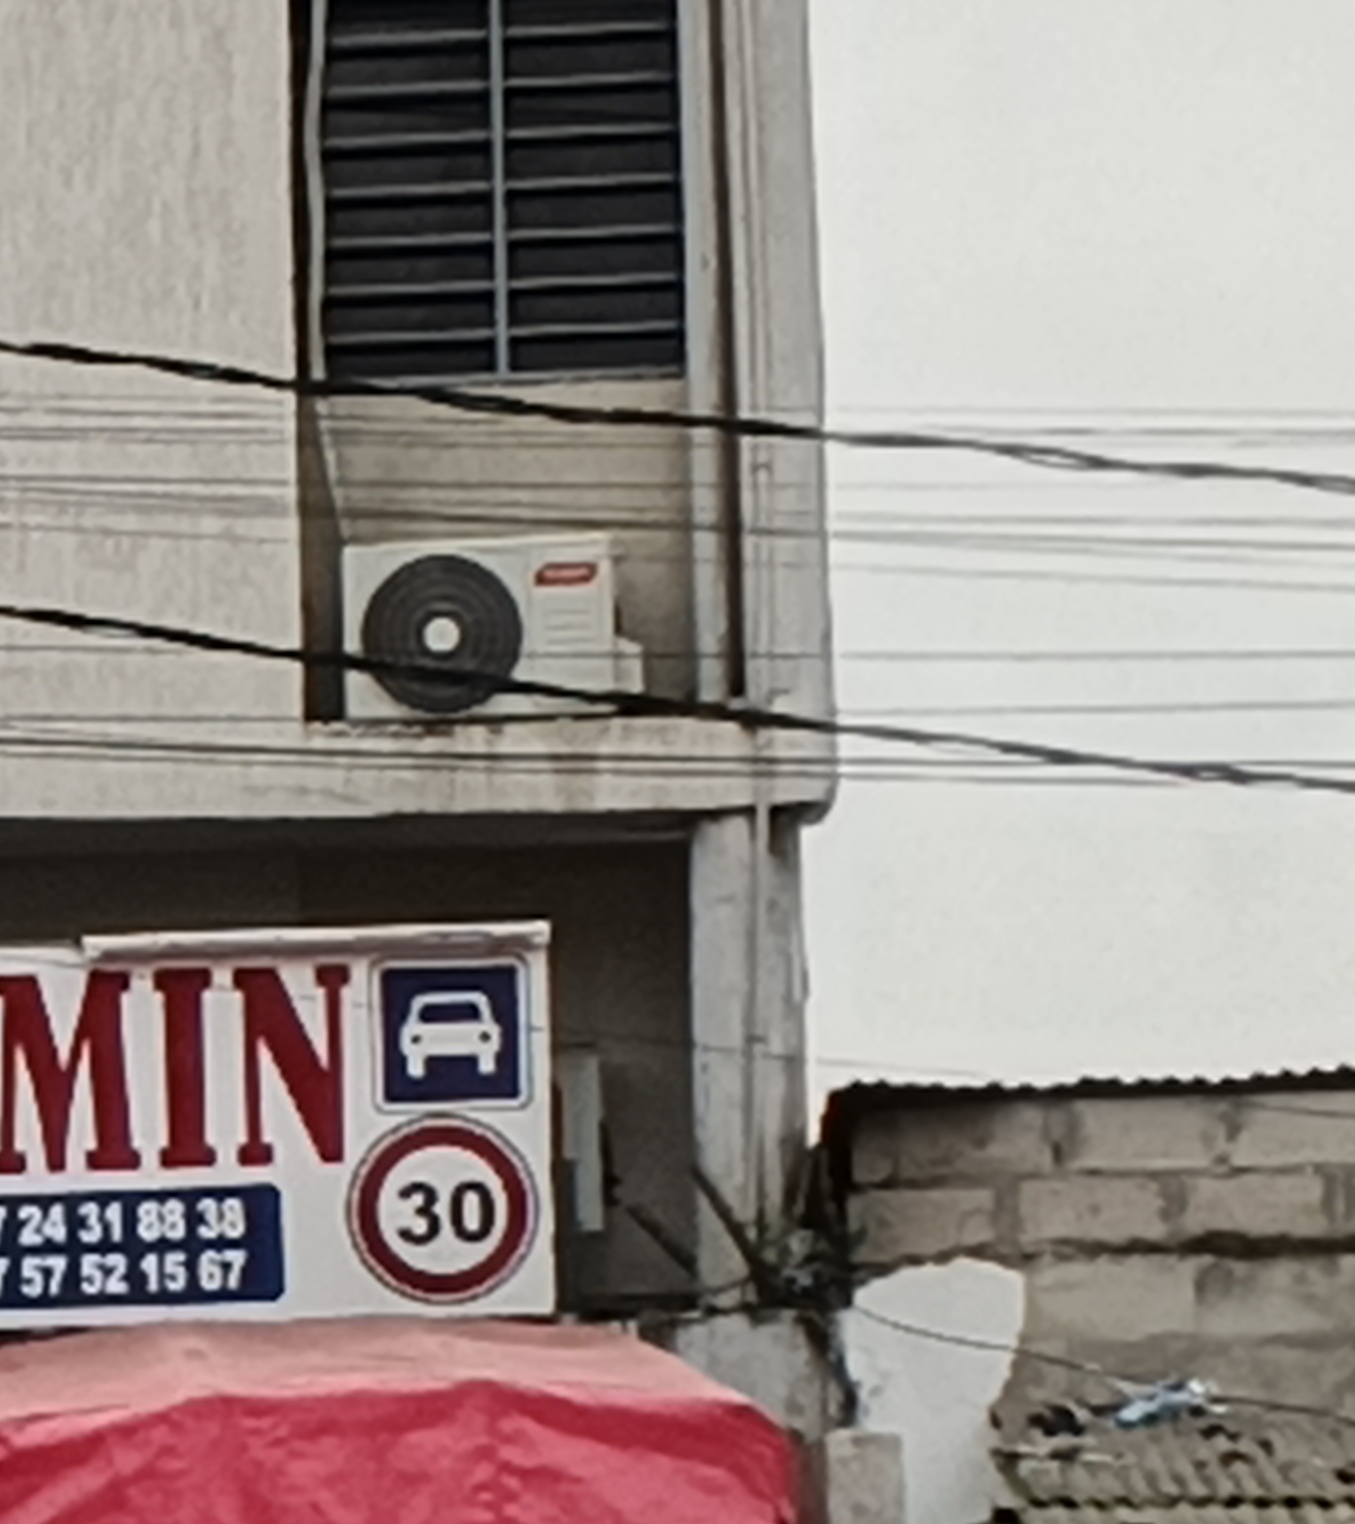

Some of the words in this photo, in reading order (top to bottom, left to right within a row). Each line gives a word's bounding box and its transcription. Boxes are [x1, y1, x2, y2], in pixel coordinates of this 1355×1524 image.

[18, 1203, 67, 1246] 24
[77, 1201, 123, 1243] 31
[137, 1199, 186, 1242] 88
[396, 1182, 495, 1246] 30
[20, 1255, 68, 1297] 57
[80, 1252, 129, 1295] 52
[140, 1251, 188, 1293] 15
[198, 1249, 247, 1292] 67
